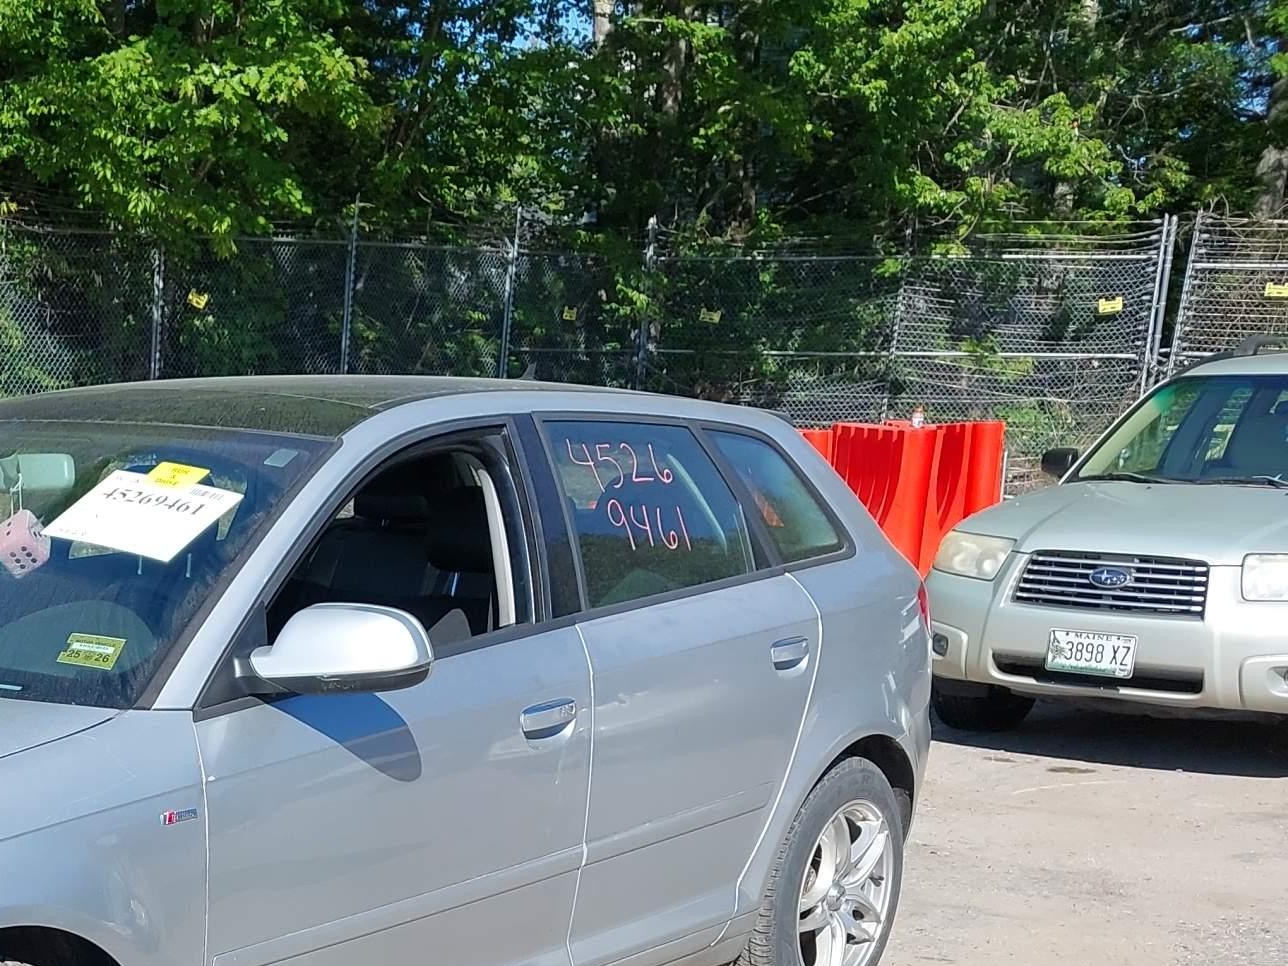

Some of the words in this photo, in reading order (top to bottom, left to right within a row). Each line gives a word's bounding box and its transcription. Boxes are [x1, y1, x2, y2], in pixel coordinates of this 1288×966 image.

[565, 438, 673, 493] 4526
[103, 487, 205, 515] 45269461
[607, 499, 691, 551] 9461
[1074, 632, 1113, 642] MAINE
[66, 649, 82, 659] 25
[94, 653, 111, 663] 26
[1064, 640, 1105, 664] 3898
[1109, 644, 1131, 667] XZ
